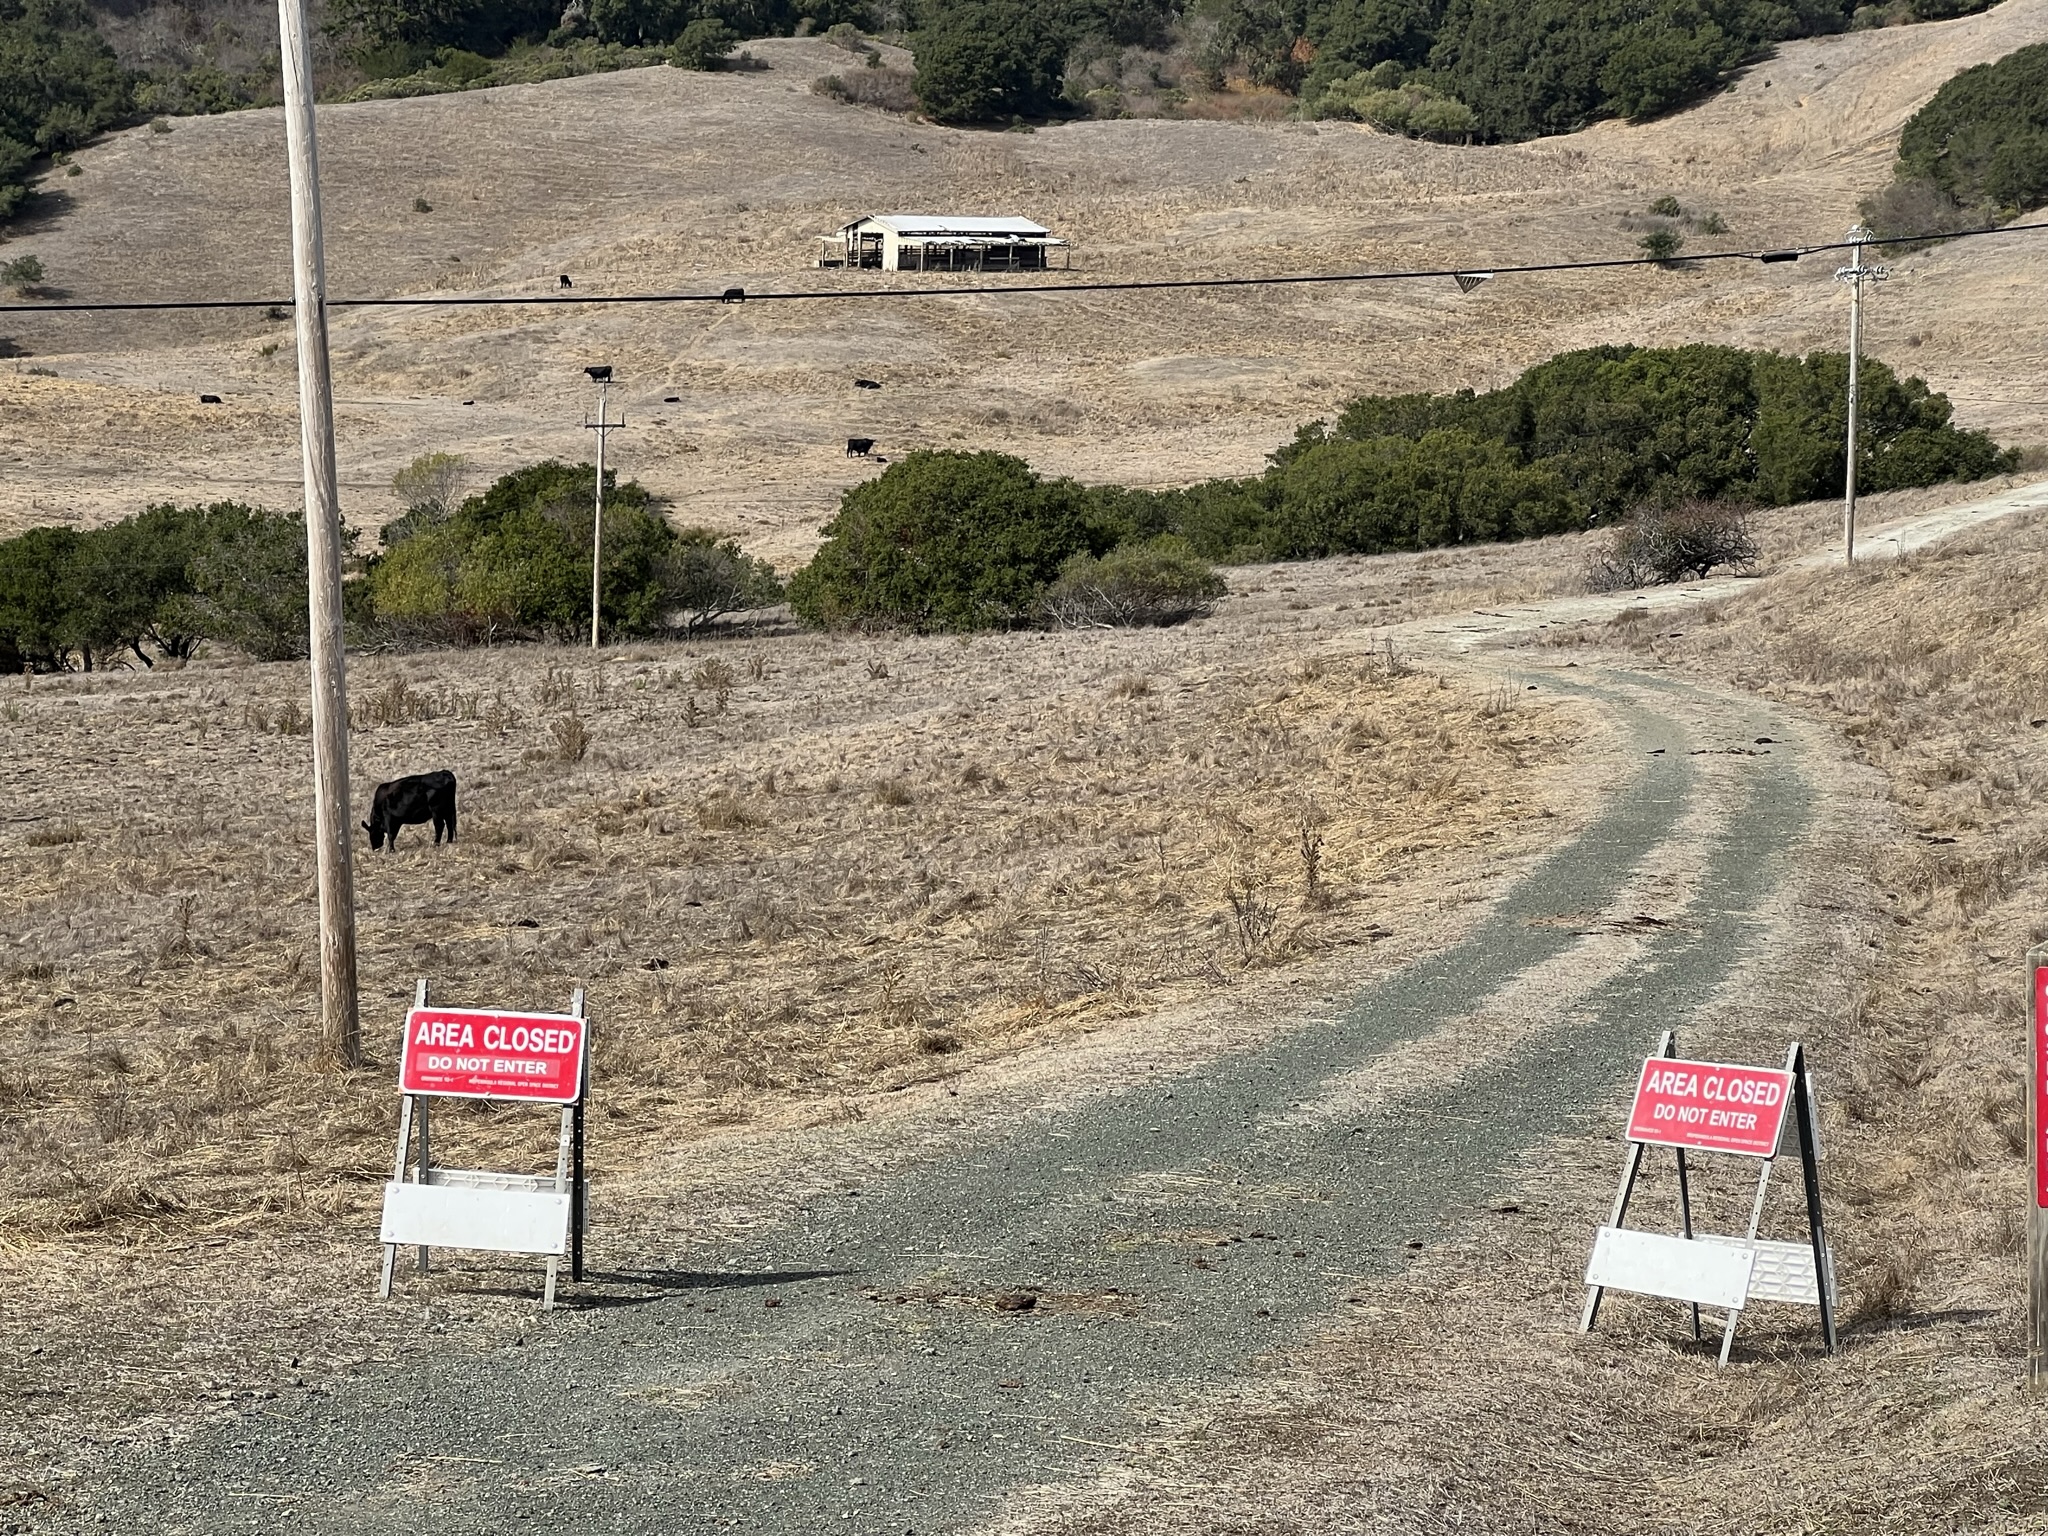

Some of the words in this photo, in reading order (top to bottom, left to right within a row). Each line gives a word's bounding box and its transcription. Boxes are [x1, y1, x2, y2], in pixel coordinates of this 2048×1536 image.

[415, 1022, 474, 1048] AREA
[483, 1025, 575, 1054] CLOSED
[428, 1056, 452, 1070] DO
[456, 1058, 490, 1072] NOT
[493, 1059, 547, 1075] ENTER
[1645, 1070, 1698, 1097] AREA
[1703, 1076, 1780, 1106] CLOSED
[1653, 1103, 1675, 1120] DO
[1677, 1105, 1709, 1124] NOT
[1709, 1109, 1757, 1131] ENTER
